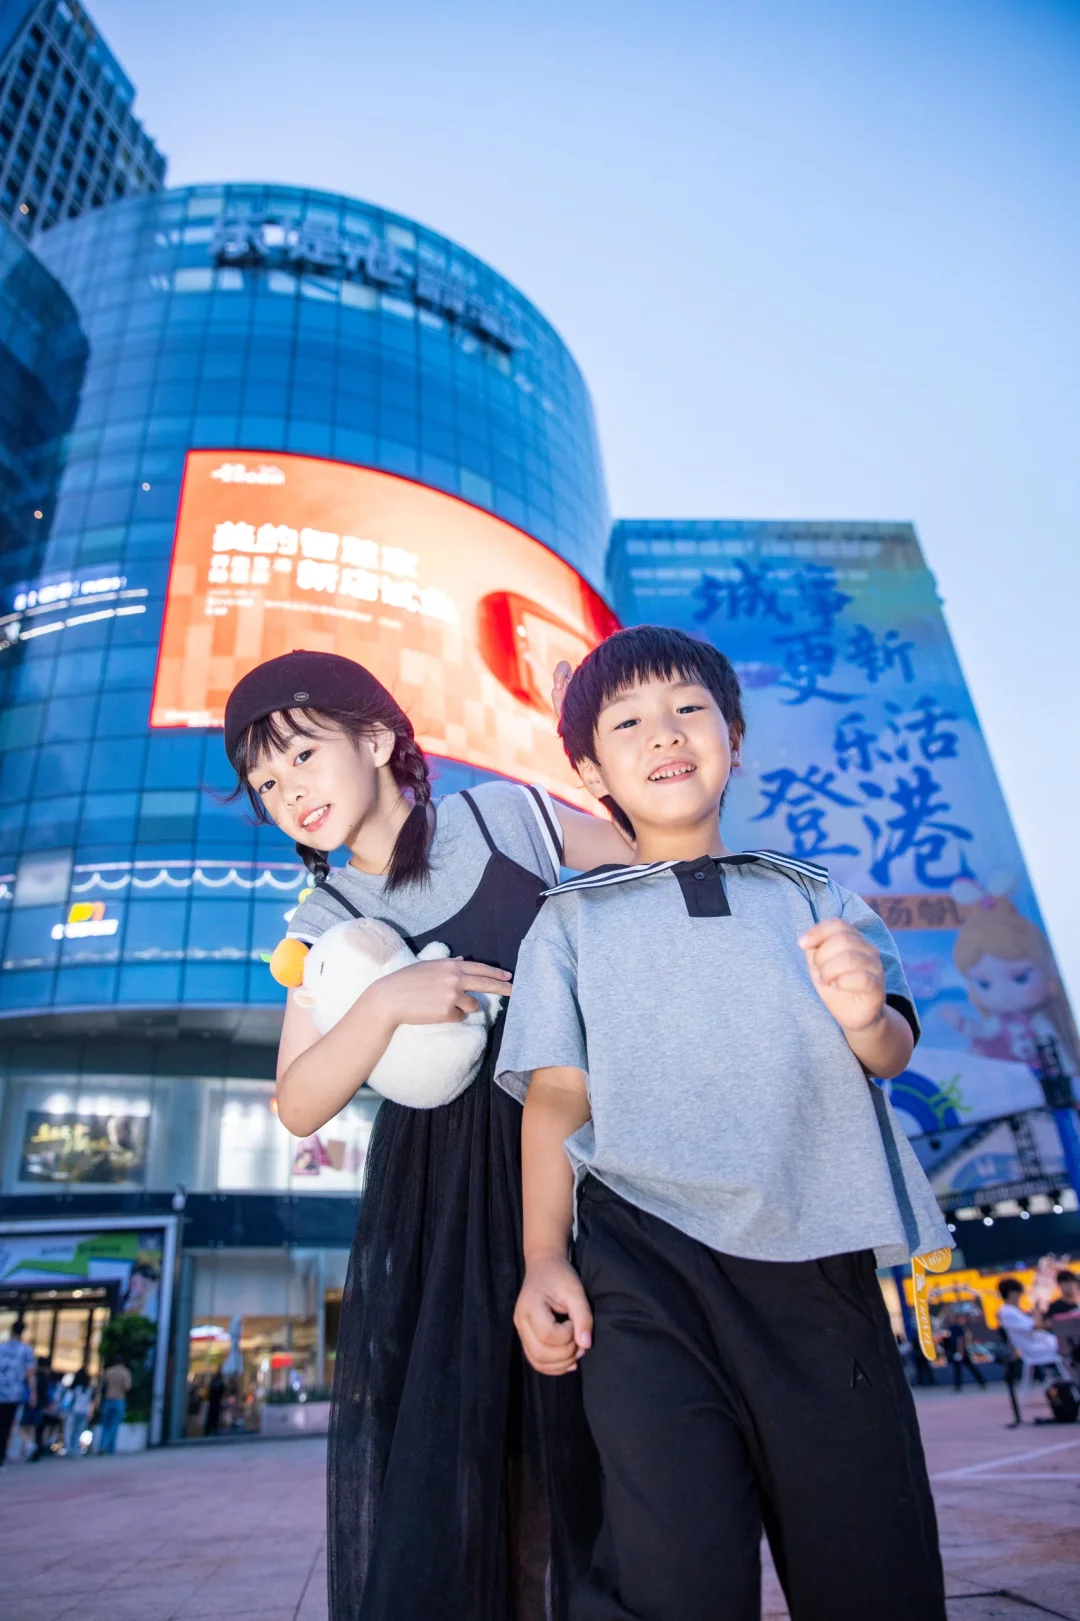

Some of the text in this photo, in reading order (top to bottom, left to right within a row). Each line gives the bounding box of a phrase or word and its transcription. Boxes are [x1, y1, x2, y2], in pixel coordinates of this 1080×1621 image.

[771, 623, 915, 705] 更新
[834, 694, 960, 773] 乐活
[749, 765, 978, 889] 登港
